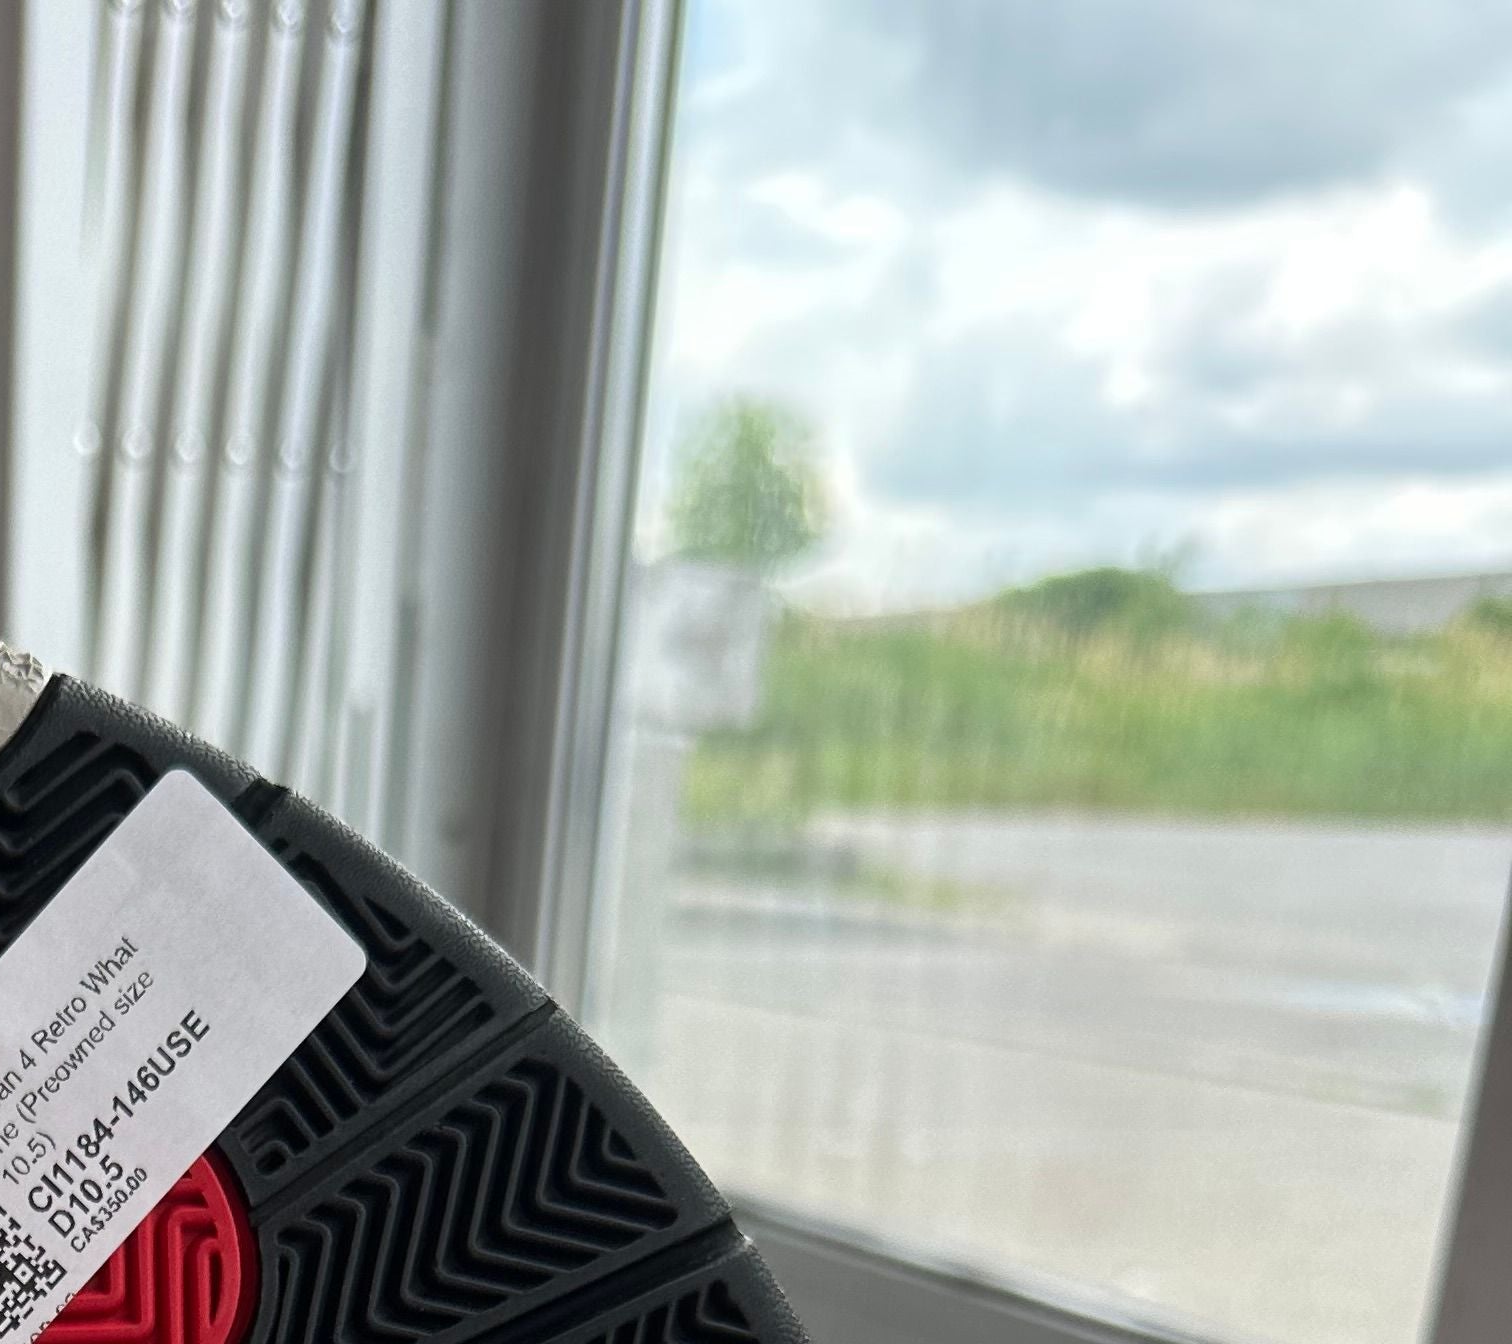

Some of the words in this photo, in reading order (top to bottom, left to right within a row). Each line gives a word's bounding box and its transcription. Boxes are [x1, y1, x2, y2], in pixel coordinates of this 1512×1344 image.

[16, 1010, 116, 1125] (Preowned
[114, 971, 155, 1016] size
[18, 1049, 37, 1071] 4
[31, 995, 87, 1055] Retro
[80, 936, 139, 996] What
[1, 1132, 57, 1185] 10.5)
[27, 1009, 210, 1213] CI1184-146USE
[48, 1154, 124, 1239] D10.5
[70, 1167, 148, 1253] CA$350.00
